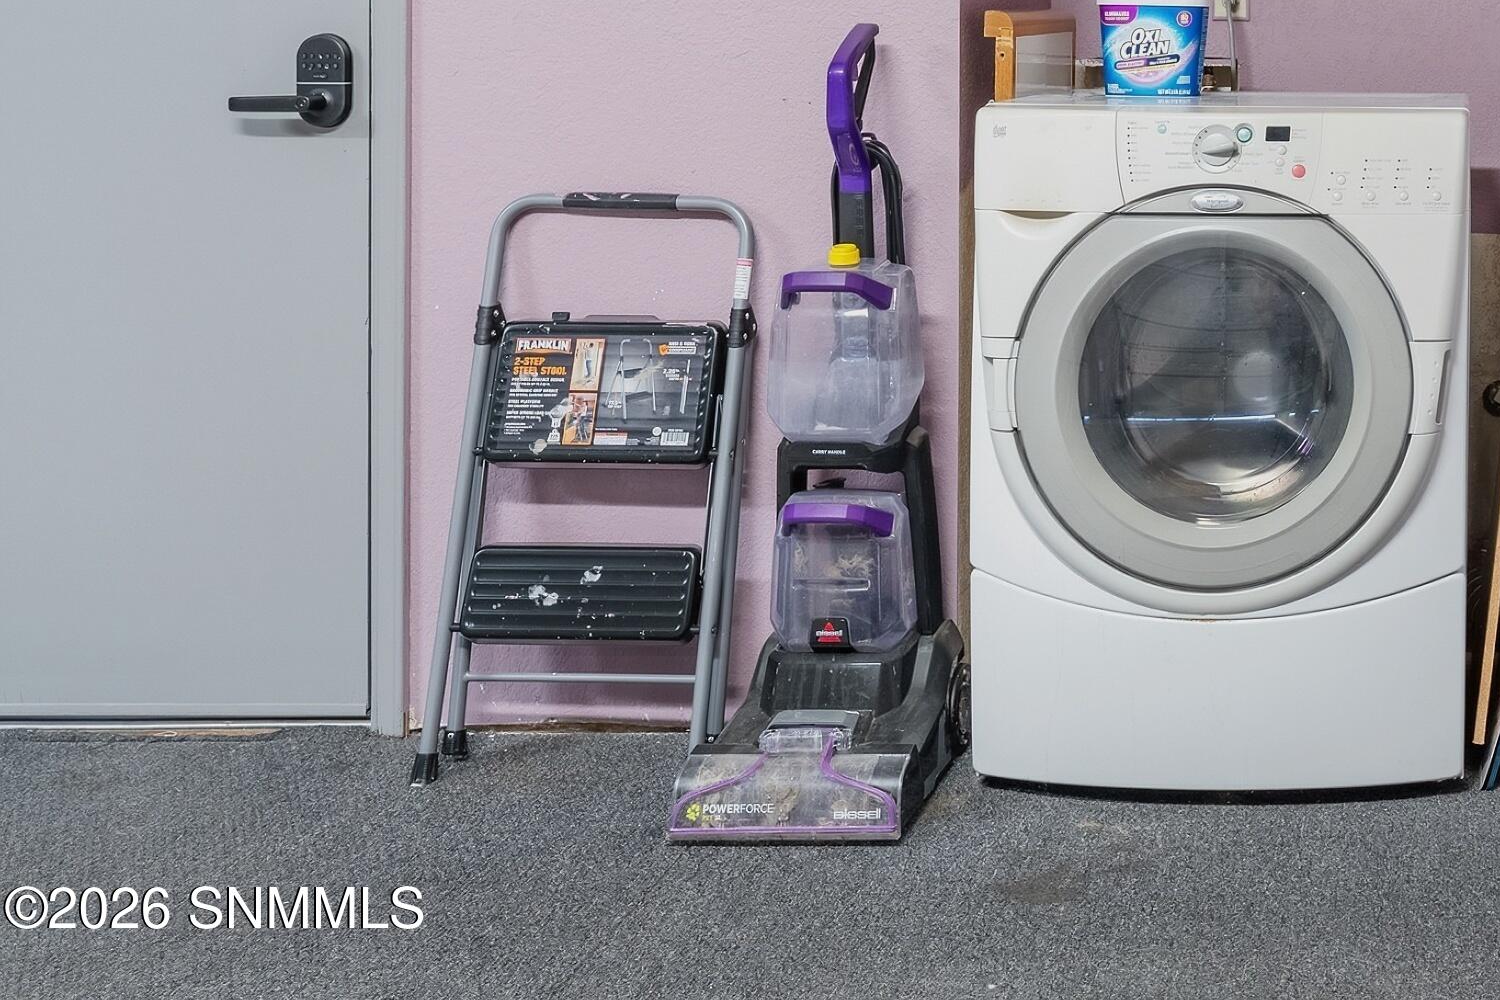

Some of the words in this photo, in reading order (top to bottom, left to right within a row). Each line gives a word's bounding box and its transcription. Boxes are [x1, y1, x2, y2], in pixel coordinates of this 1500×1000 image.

[1131, 28, 1161, 44] OXI
[1120, 40, 1171, 60] CLEAN
[517, 338, 569, 351] FRANKLIN
[513, 356, 546, 366] 2-STEP
[512, 366, 538, 376] STEEL
[540, 366, 567, 376] STOOL
[702, 803, 776, 814] POWERFORCE
